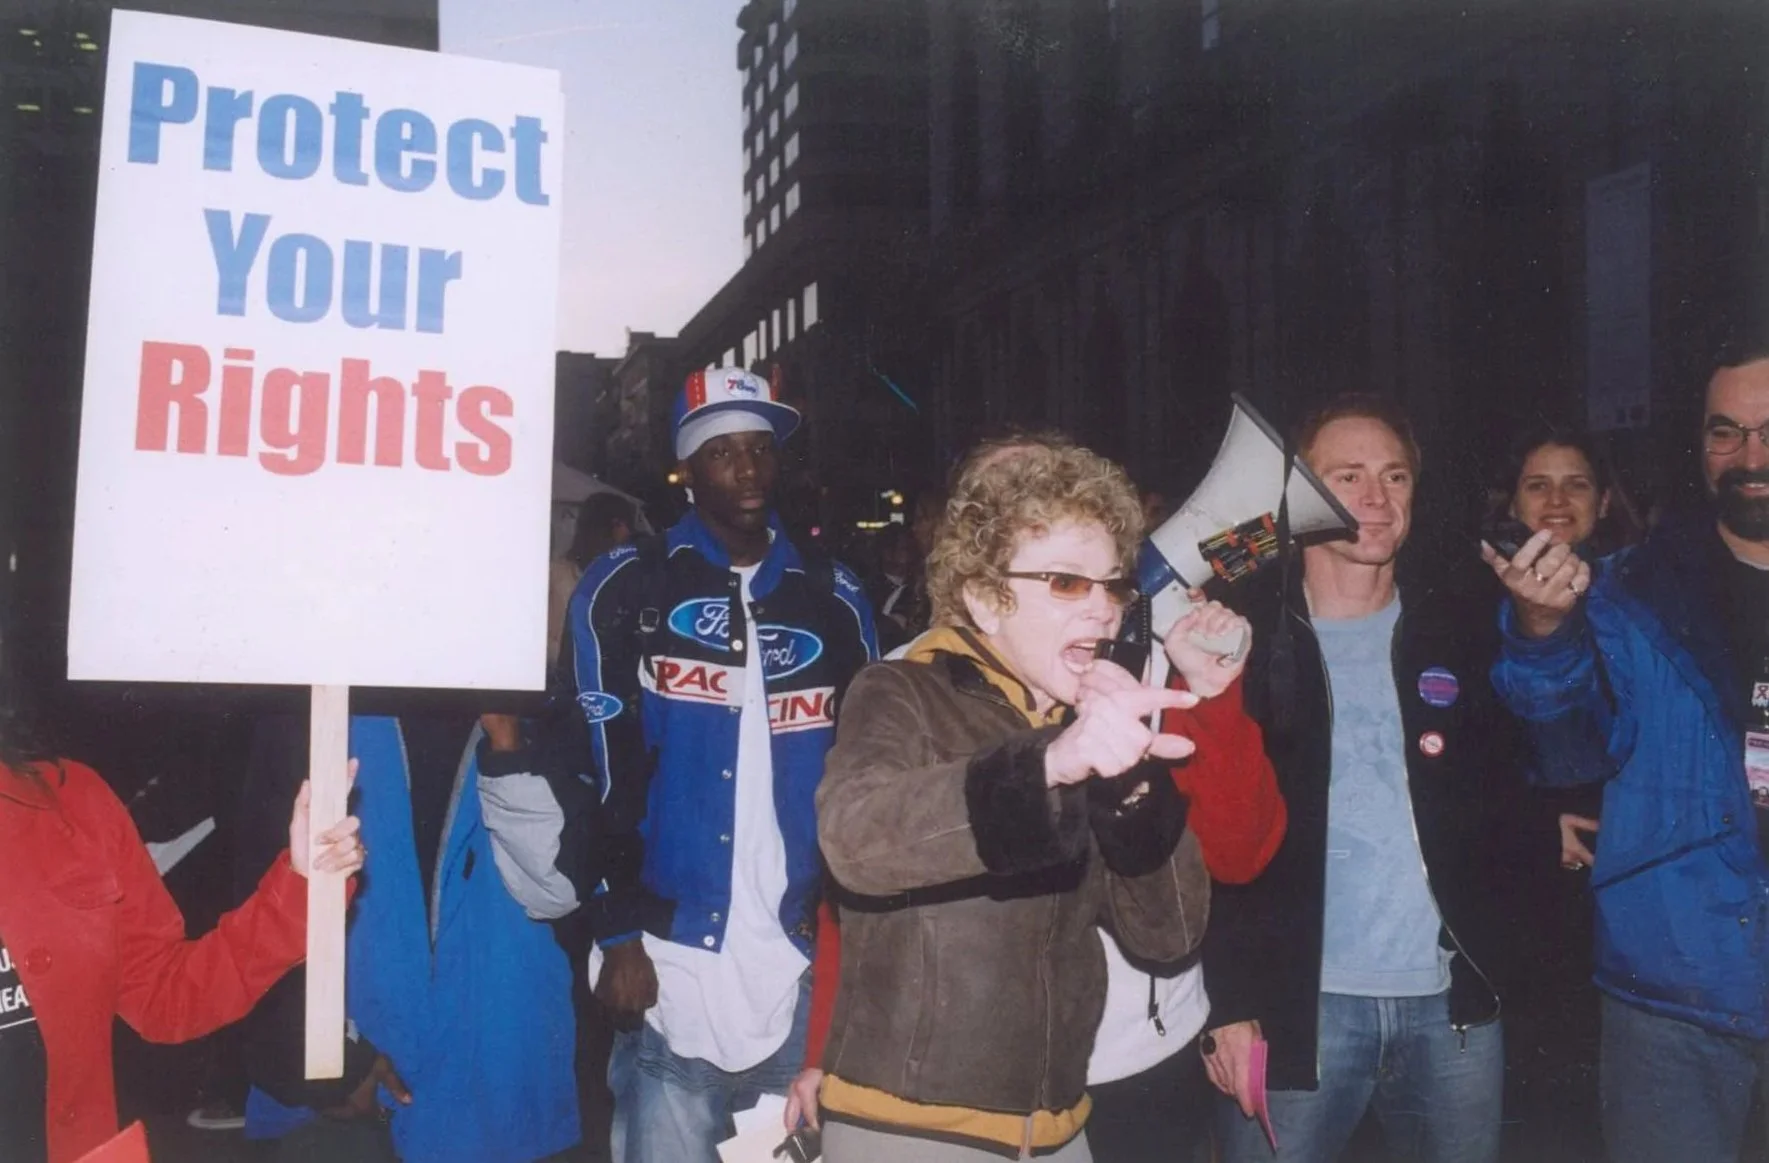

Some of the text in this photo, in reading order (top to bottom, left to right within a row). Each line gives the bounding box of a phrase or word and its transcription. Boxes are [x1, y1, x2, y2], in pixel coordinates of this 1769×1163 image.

[127, 61, 549, 206] Protect
[203, 209, 463, 334] Your
[135, 341, 515, 477] Rights
